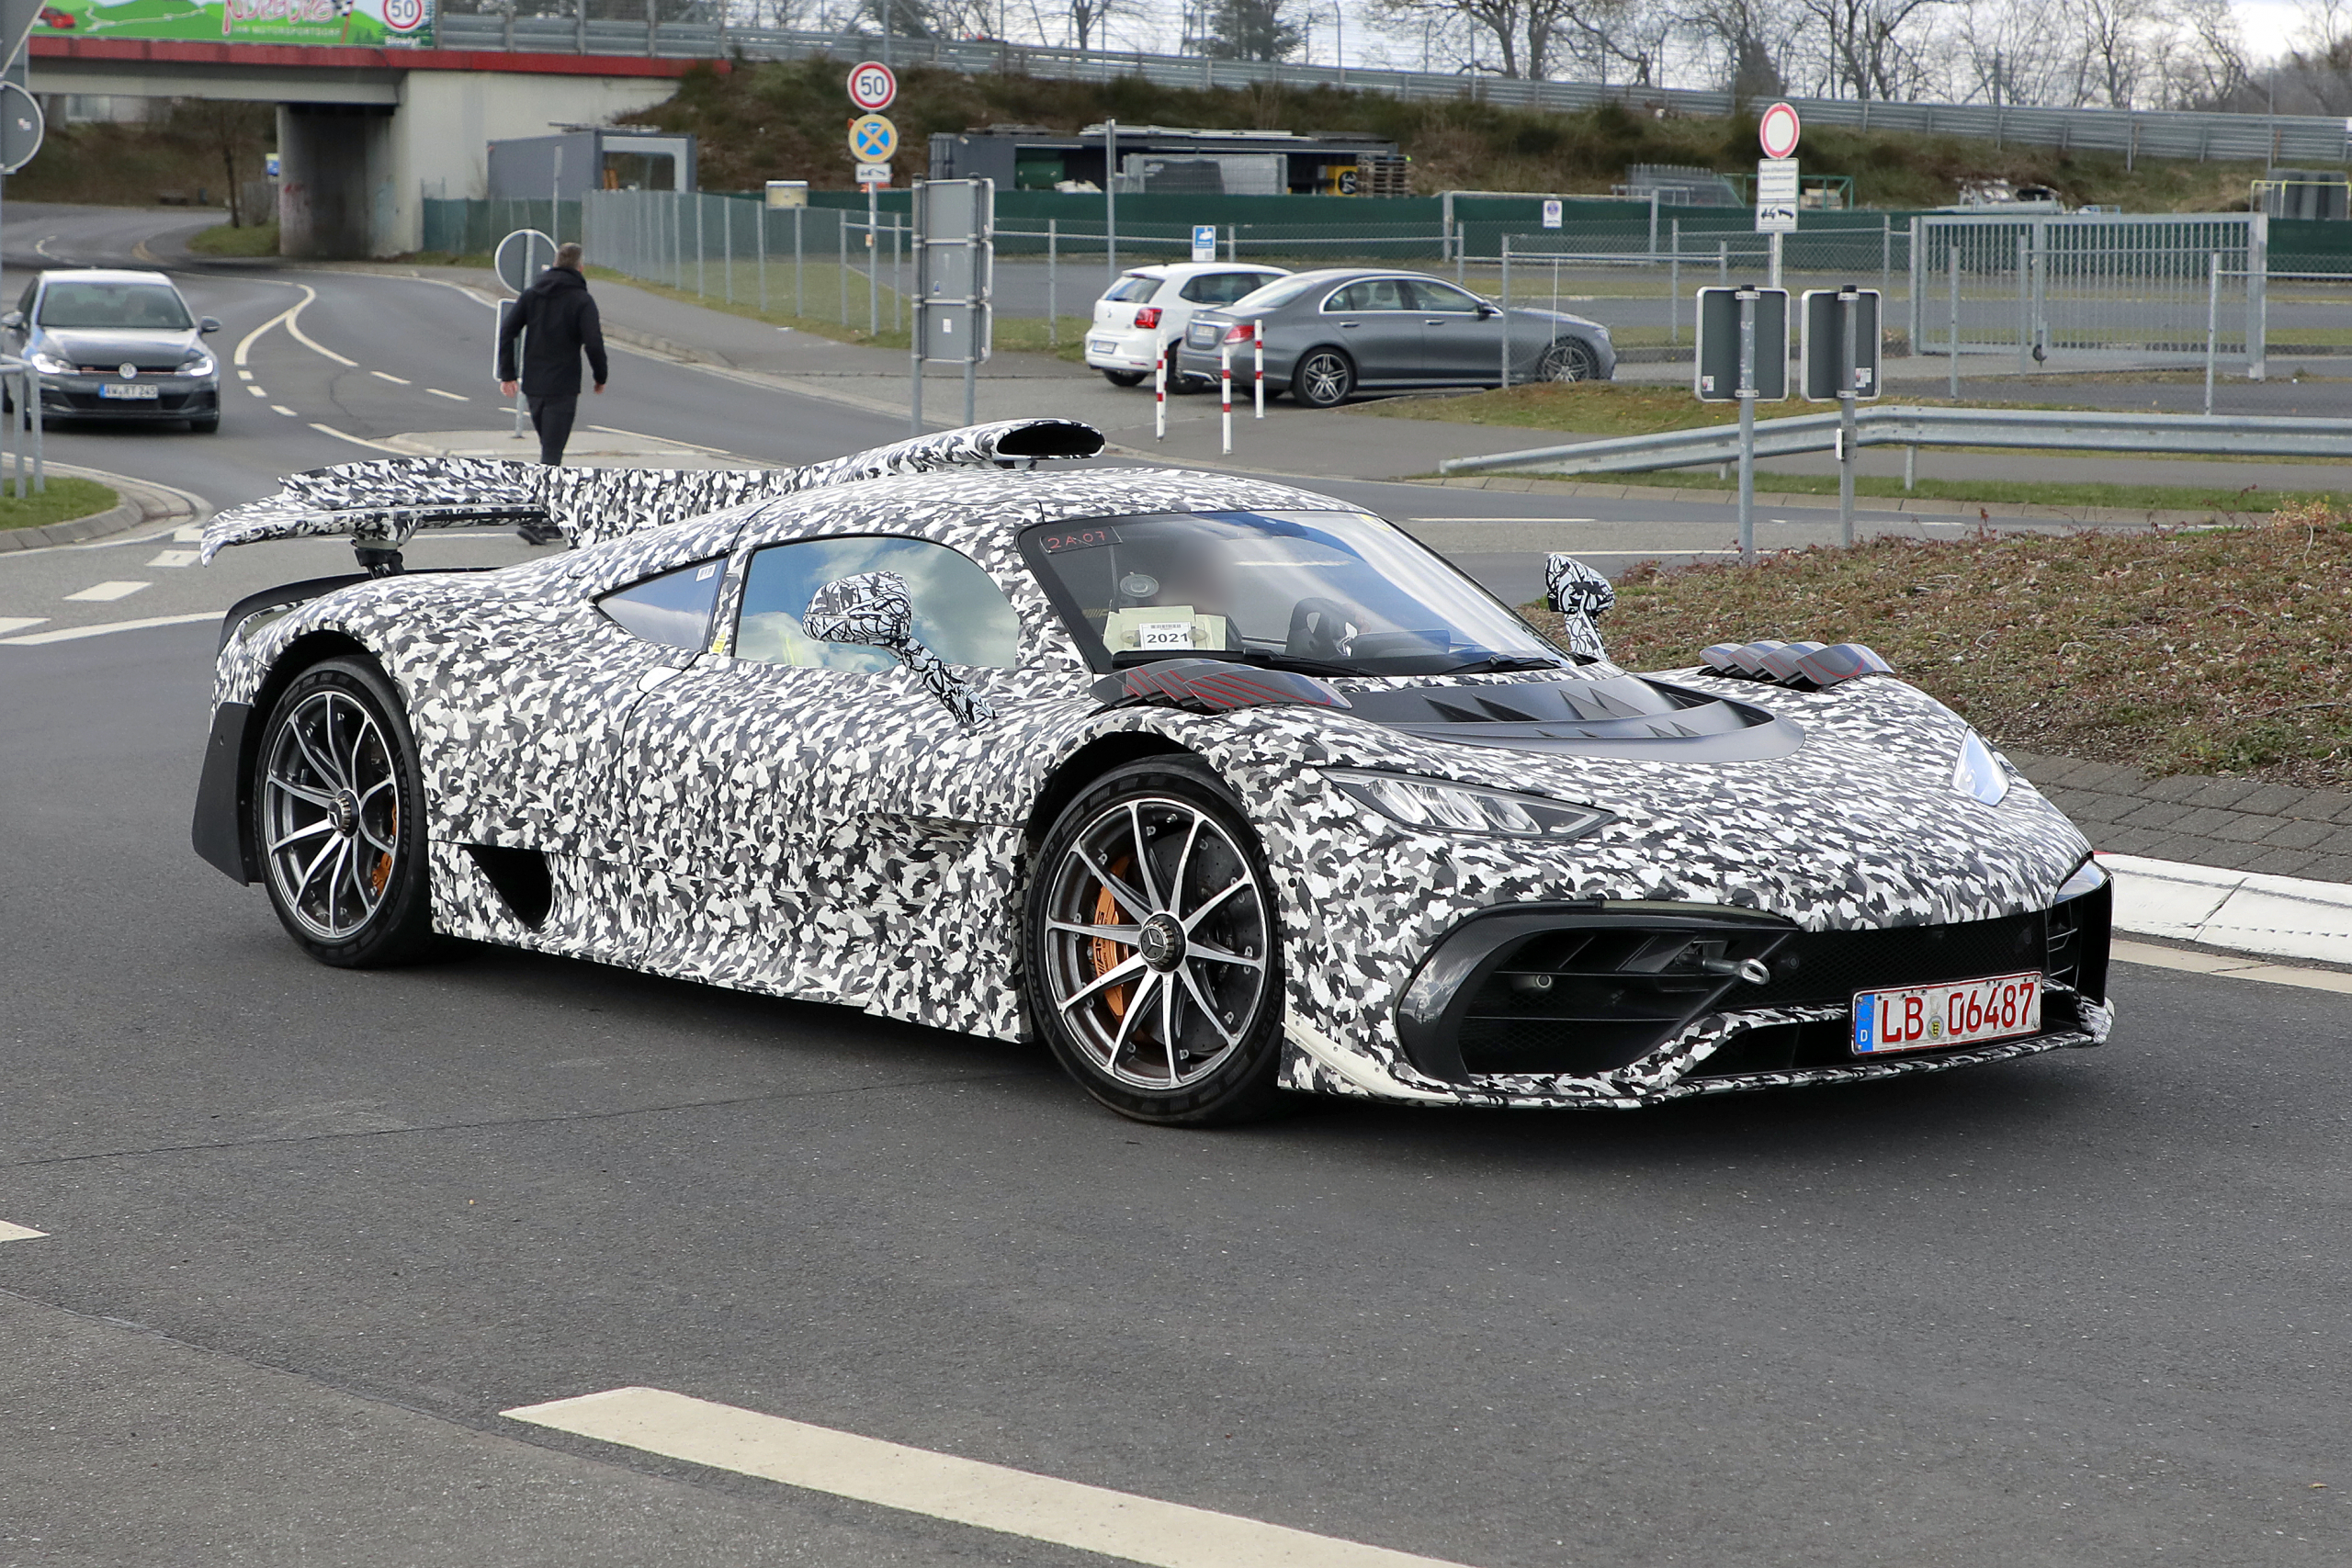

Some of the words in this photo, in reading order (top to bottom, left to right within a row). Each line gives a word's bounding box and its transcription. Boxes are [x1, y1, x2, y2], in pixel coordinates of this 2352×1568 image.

[391, 0, 414, 18] 50
[861, 75, 885, 96] 50
[1147, 633, 1188, 644] 2021
[1027, 918, 1045, 1010] MICHELIN
[1882, 997, 1924, 1043] LB
[1948, 982, 2035, 1036] 06487
[1860, 1029, 1869, 1043] D
